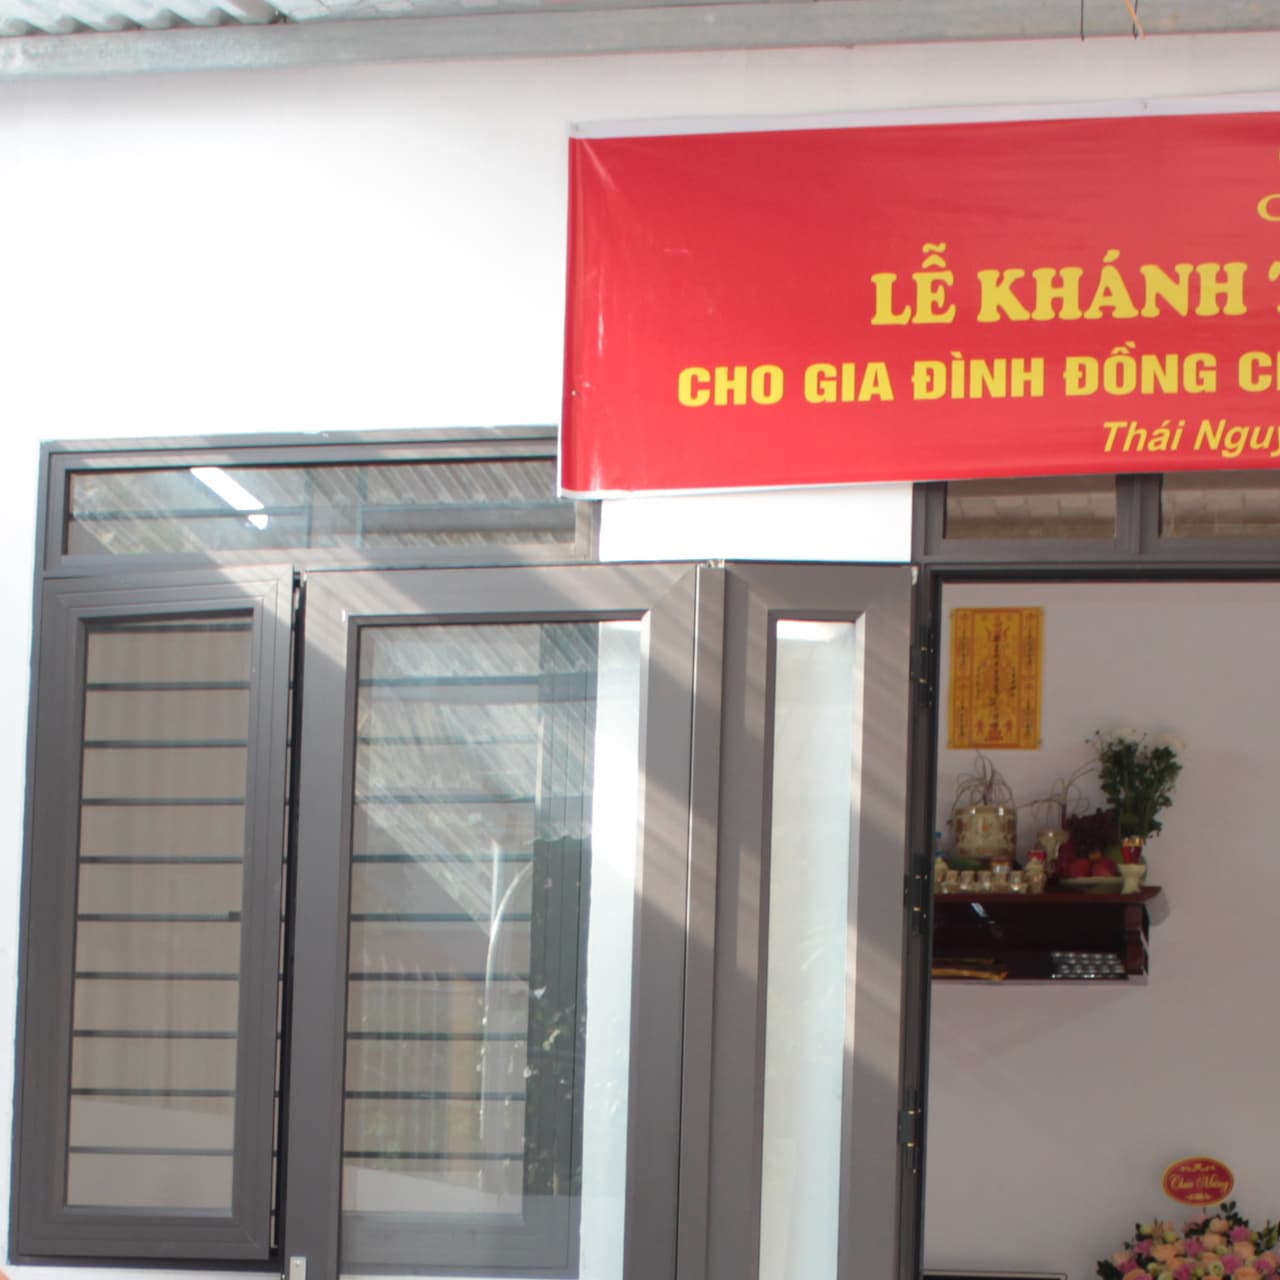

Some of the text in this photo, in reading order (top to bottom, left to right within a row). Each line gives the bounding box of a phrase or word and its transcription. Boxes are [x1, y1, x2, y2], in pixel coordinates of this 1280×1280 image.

[871, 242, 956, 325] LỄ
[977, 248, 1248, 323] KHÁNH
[677, 364, 784, 408] CHO
[804, 361, 894, 404] GIA
[911, 351, 1045, 400] ĐÌNH
[1062, 341, 1217, 397] ĐỒNG
[1104, 420, 1186, 452] Thái
